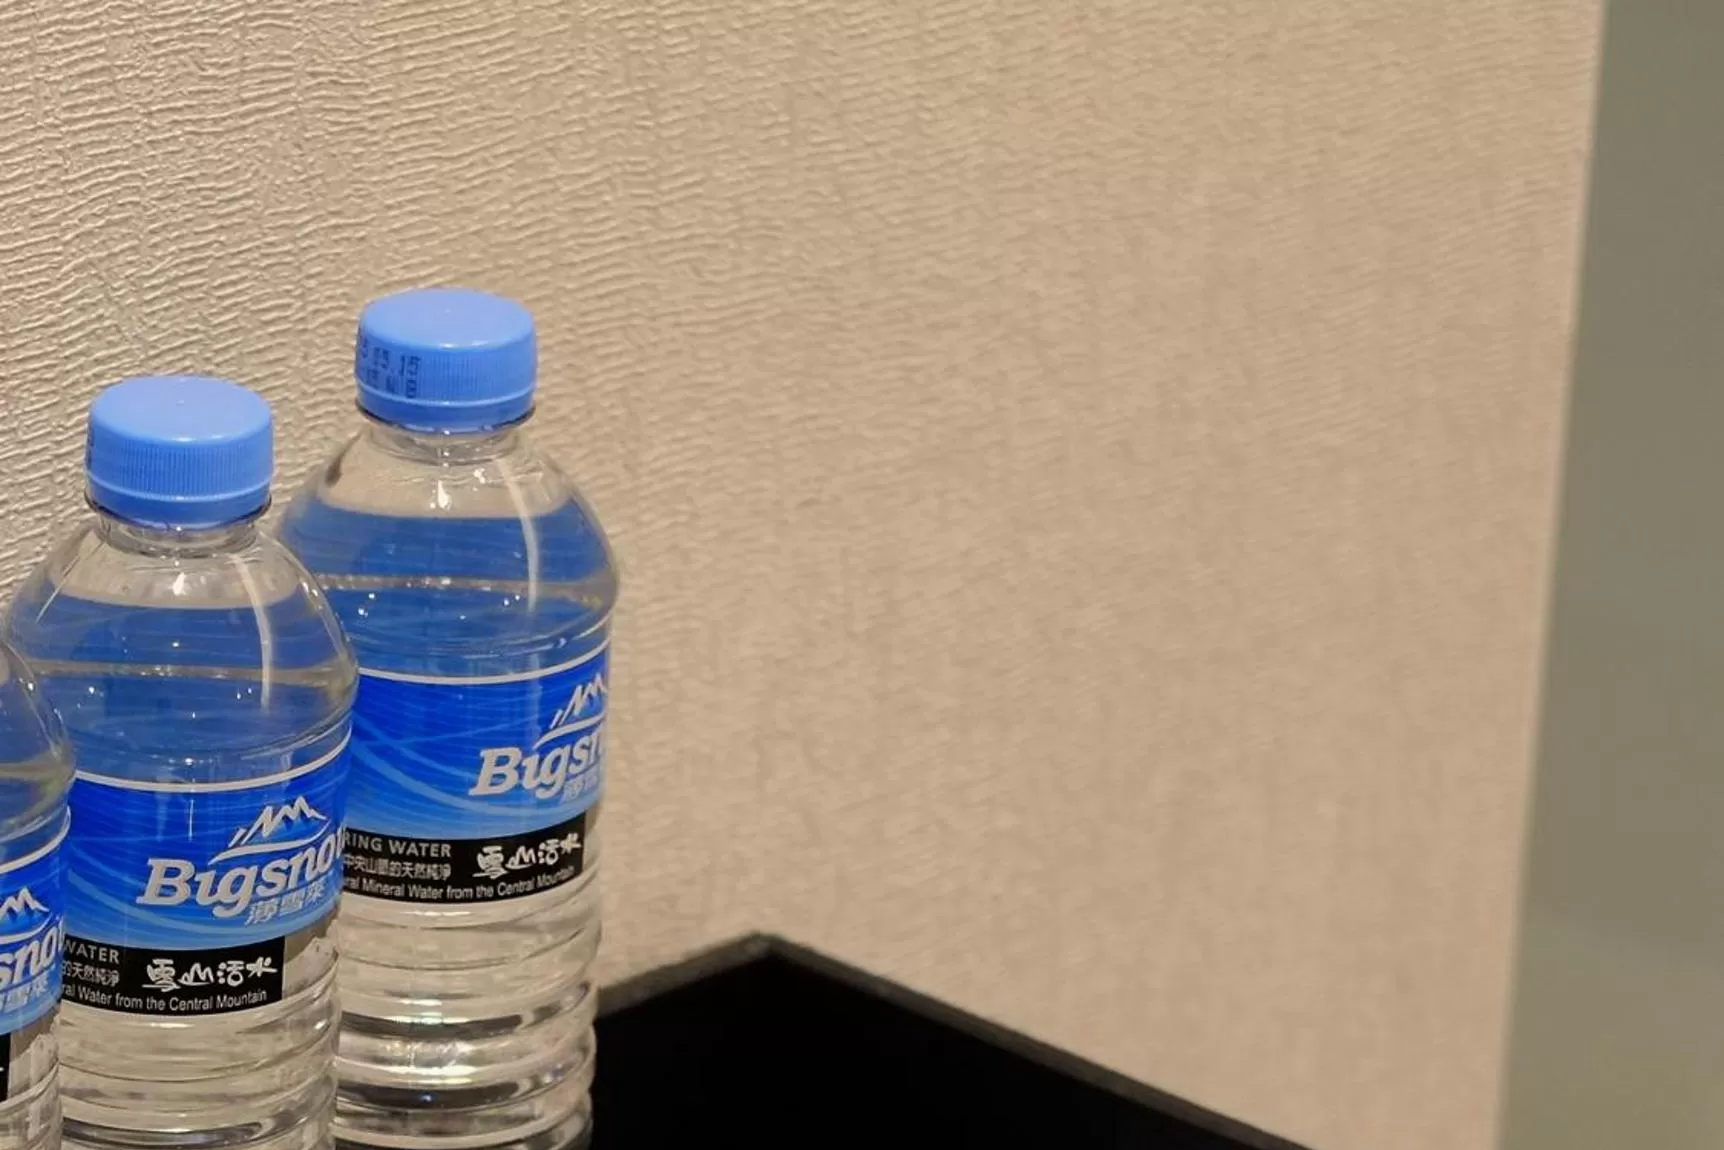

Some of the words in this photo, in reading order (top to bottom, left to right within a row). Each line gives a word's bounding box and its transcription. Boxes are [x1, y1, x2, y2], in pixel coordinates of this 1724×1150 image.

[344, 833, 382, 852] RING
[388, 838, 452, 858] WATER
[362, 877, 404, 897] Mineral
[407, 883, 444, 899] Water
[446, 883, 473, 899] from
[476, 883, 494, 899] the
[497, 876, 535, 897] Central
[537, 864, 575, 889] Mountain
[78, 985, 114, 1006] Water
[116, 993, 143, 1011] from
[146, 994, 165, 1011] the
[169, 993, 213, 1012] Central
[216, 988, 267, 1010] Mountain
